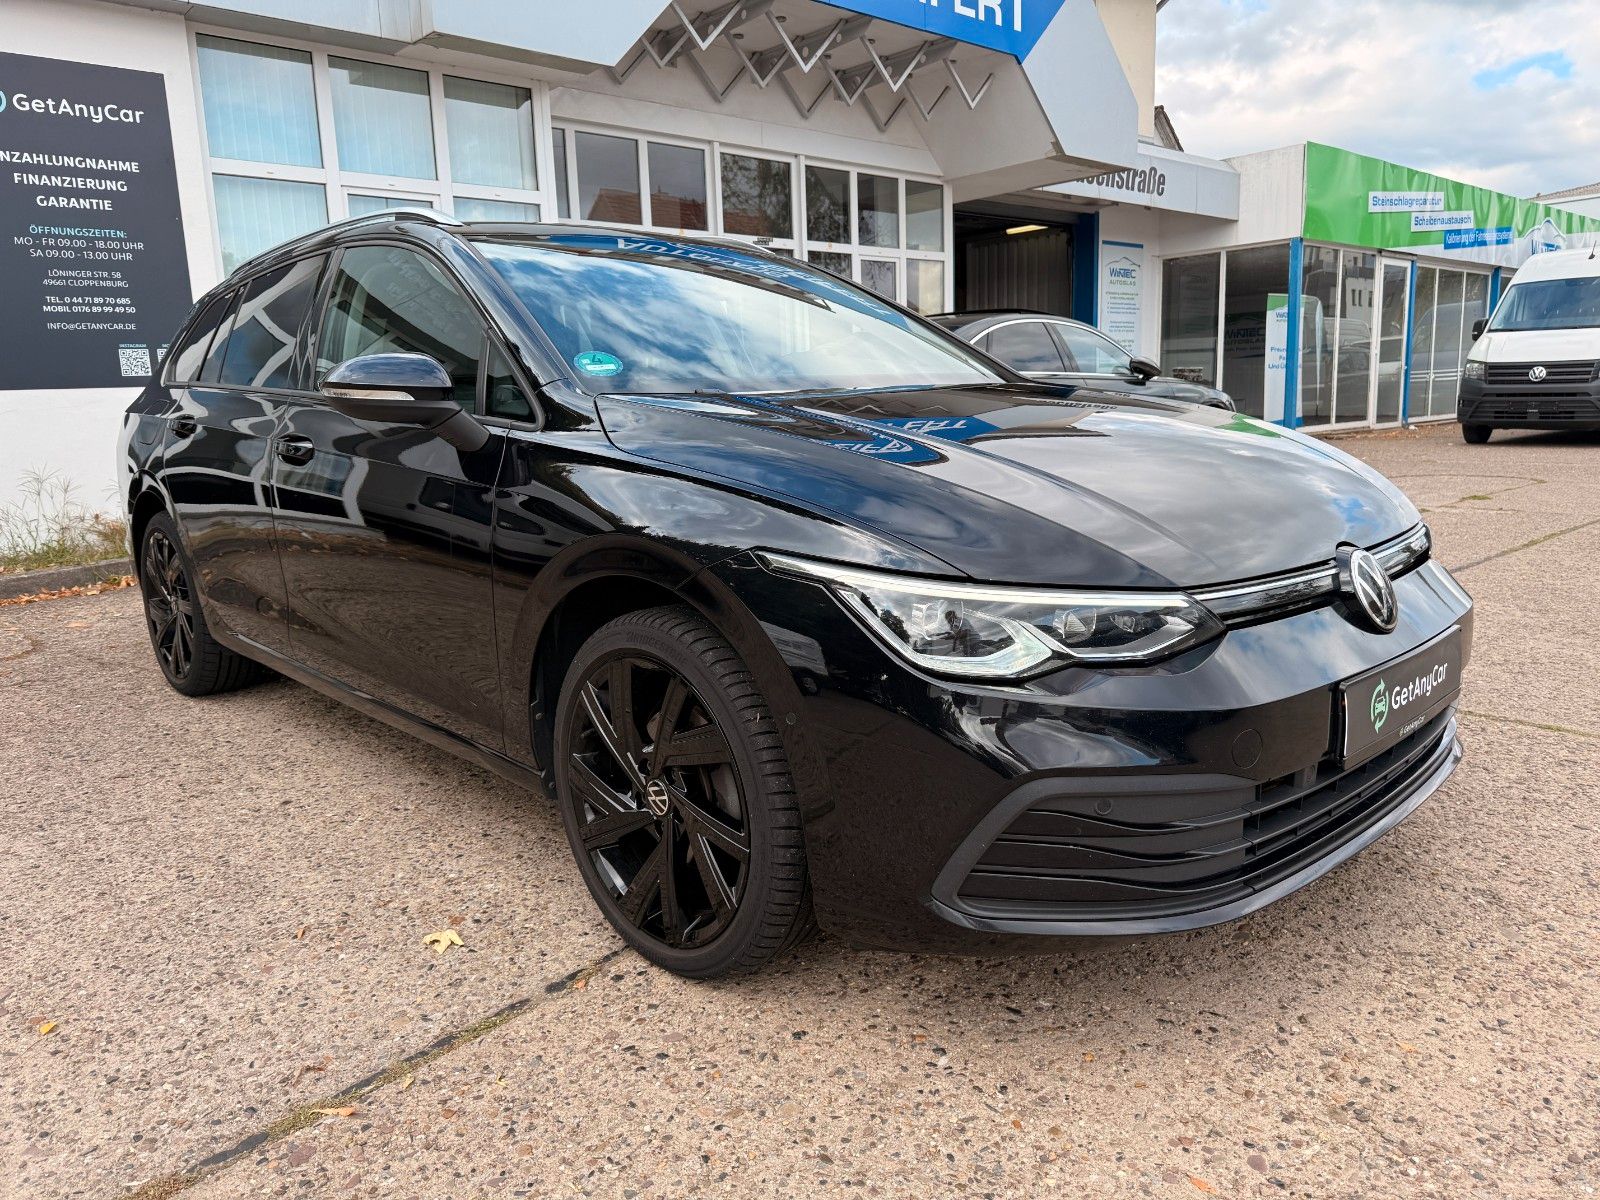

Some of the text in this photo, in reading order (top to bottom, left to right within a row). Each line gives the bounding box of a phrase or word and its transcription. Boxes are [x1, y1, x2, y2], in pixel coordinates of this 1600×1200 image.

[13, 94, 144, 123] GetAnyCar
[0, 151, 139, 172] NZAHLUNGNAHME
[14, 173, 127, 191] FINANZIERUNG
[37, 196, 112, 210] GARANTIE
[1372, 196, 1442, 207] Steinschlagrepatur
[30, 224, 127, 239] ÖFFNUNGSZEITEN:
[14, 237, 32, 245] MO
[43, 238, 55, 246] FR
[58, 239, 86, 247] 09.00
[95, 241, 120, 249] 18.00
[123, 242, 144, 250] UHR
[30, 249, 43, 257] SA
[46, 250, 74, 258] 09.00
[83, 251, 108, 259] 13.00
[48, 269, 92, 277] LÖNINGER
[1392, 663, 1448, 710] GetAnyCar
